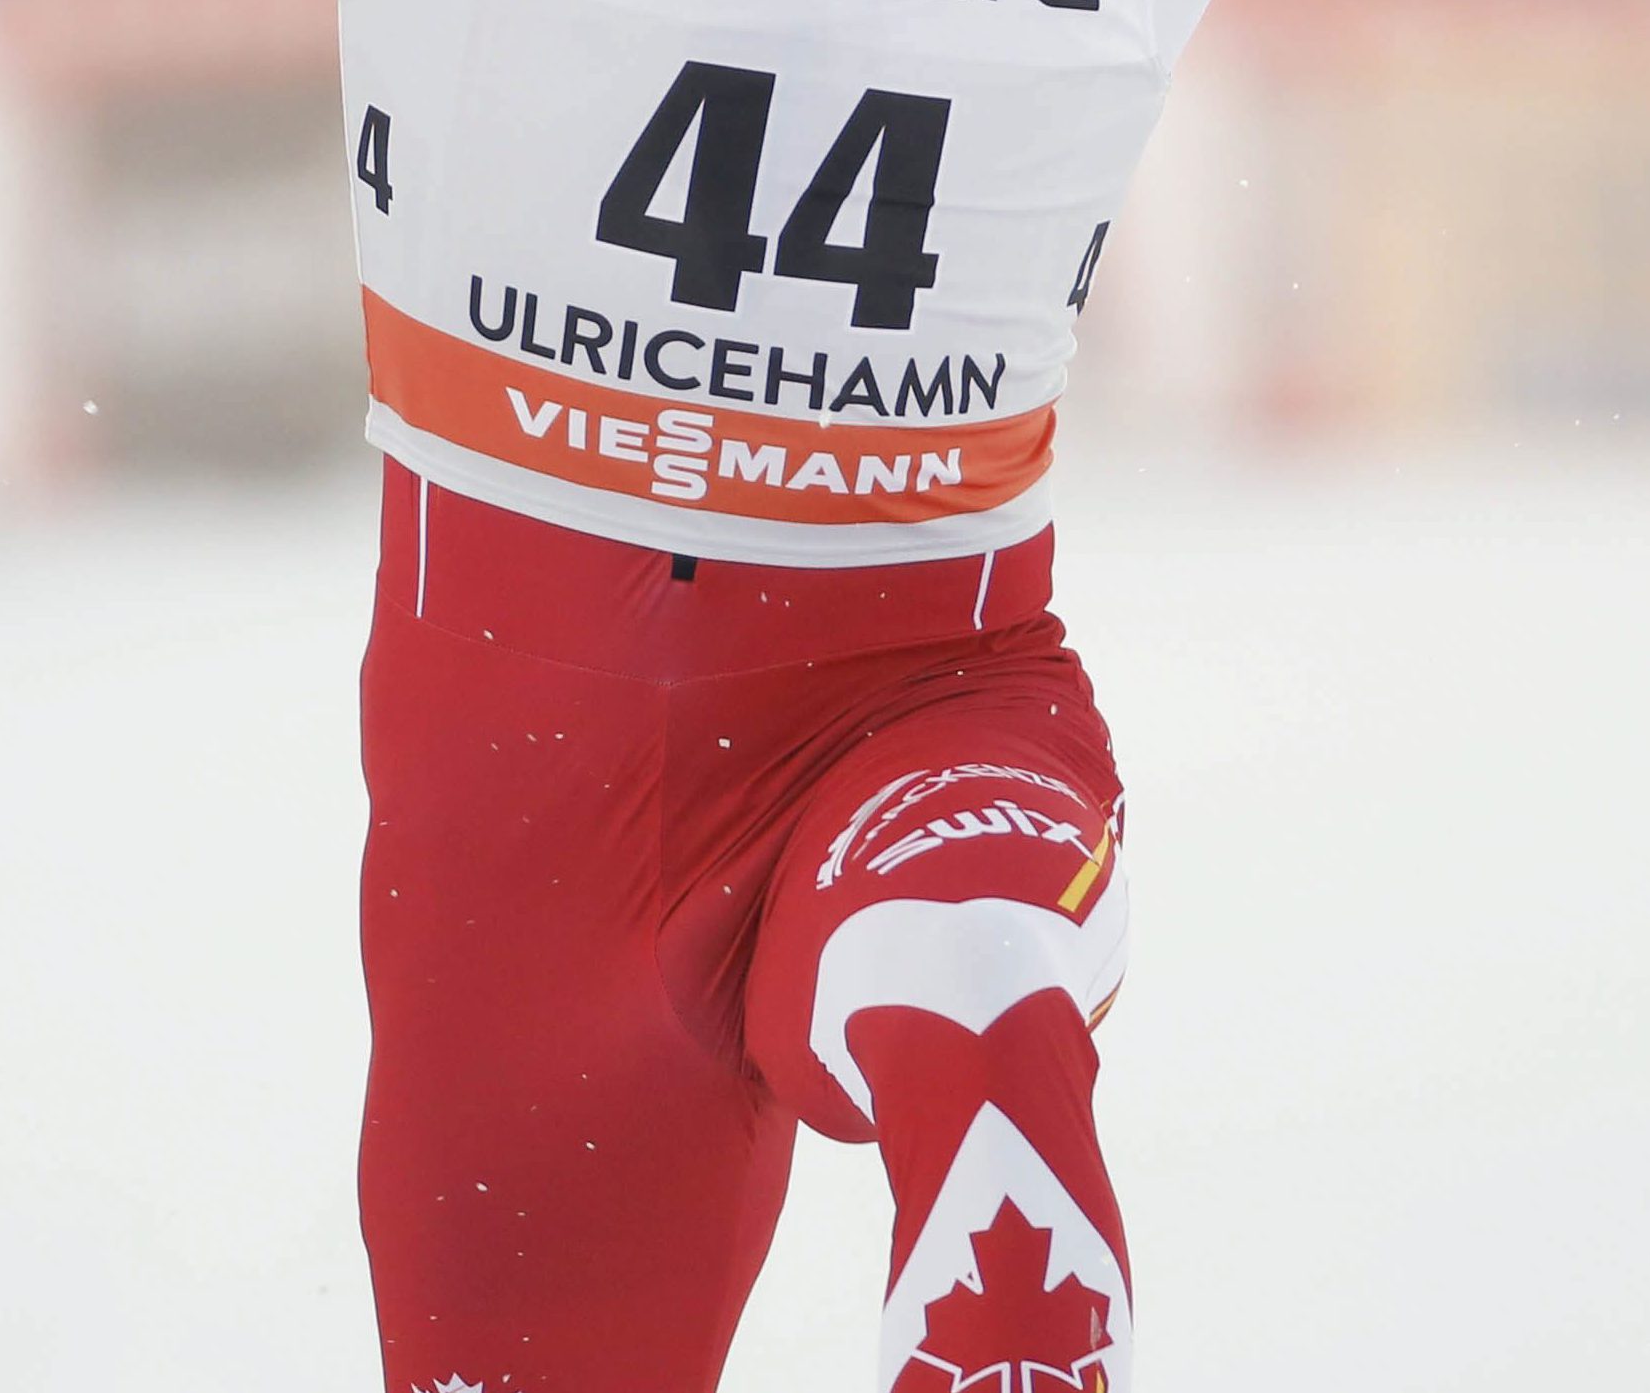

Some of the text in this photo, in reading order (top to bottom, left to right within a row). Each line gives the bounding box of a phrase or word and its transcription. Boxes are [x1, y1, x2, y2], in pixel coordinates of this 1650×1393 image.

[356, 103, 394, 217] 4
[595, 59, 952, 331] 44
[468, 274, 1006, 417] ULRICEHAMN
[504, 385, 963, 502] VIESSMANN
[865, 798, 1101, 875] swix
